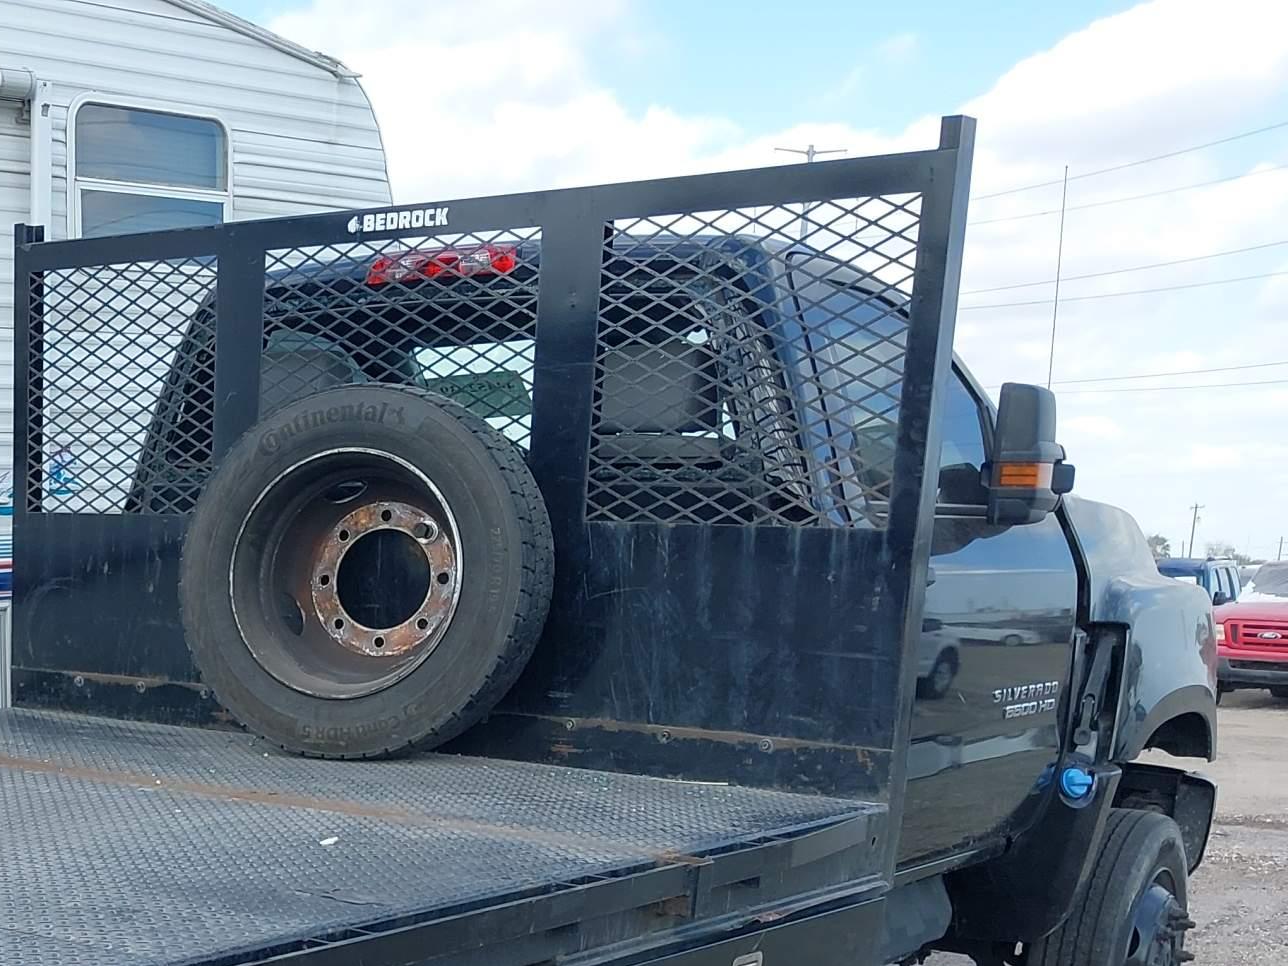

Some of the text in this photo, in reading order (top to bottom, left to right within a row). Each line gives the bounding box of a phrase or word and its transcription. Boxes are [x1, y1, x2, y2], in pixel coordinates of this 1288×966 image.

[363, 207, 449, 232] BEDROCK
[259, 400, 389, 456] Continental
[993, 681, 1059, 703] SILVERADO
[1038, 699, 1056, 713] HD
